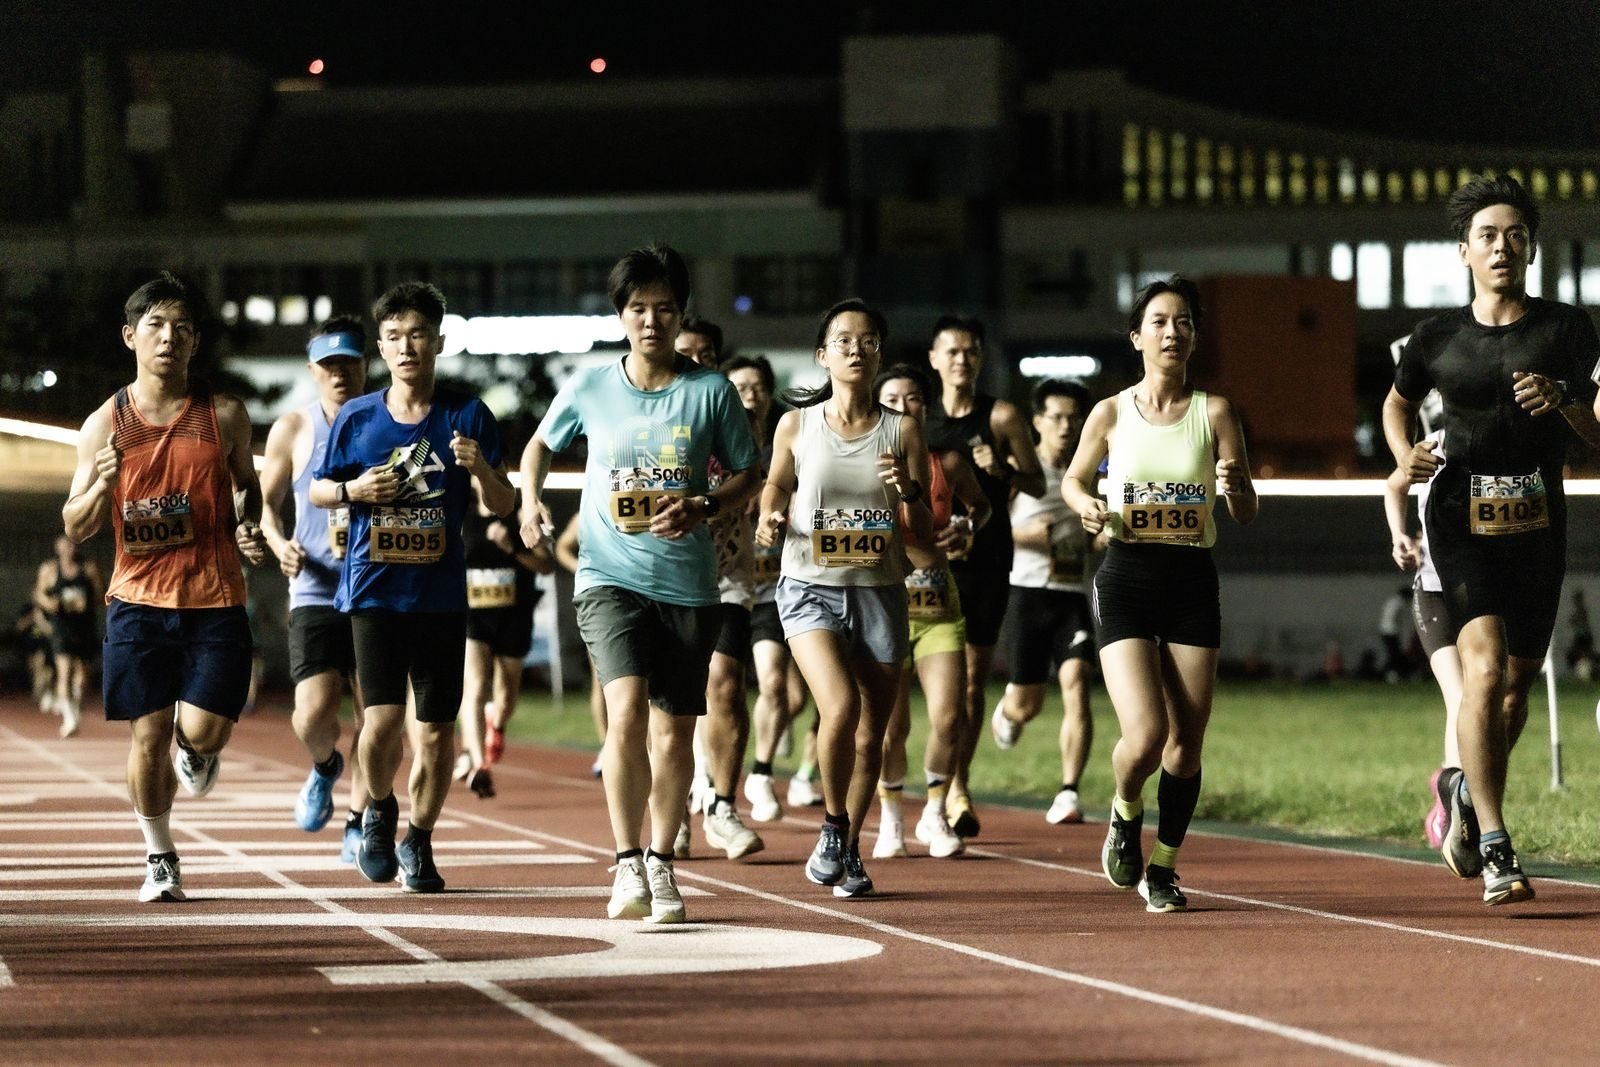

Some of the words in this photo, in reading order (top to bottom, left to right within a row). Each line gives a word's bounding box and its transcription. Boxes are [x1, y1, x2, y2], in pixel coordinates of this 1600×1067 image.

[1123, 482, 1134, 504] 高雄
[1165, 482, 1206, 496] 5000
[149, 493, 189, 510] 5000
[814, 509, 824, 530] 高雄
[853, 509, 893, 522] 5000
[1131, 509, 1199, 529] B136
[123, 519, 188, 543] B004
[378, 532, 440, 551] B095
[821, 534, 886, 554] B140
